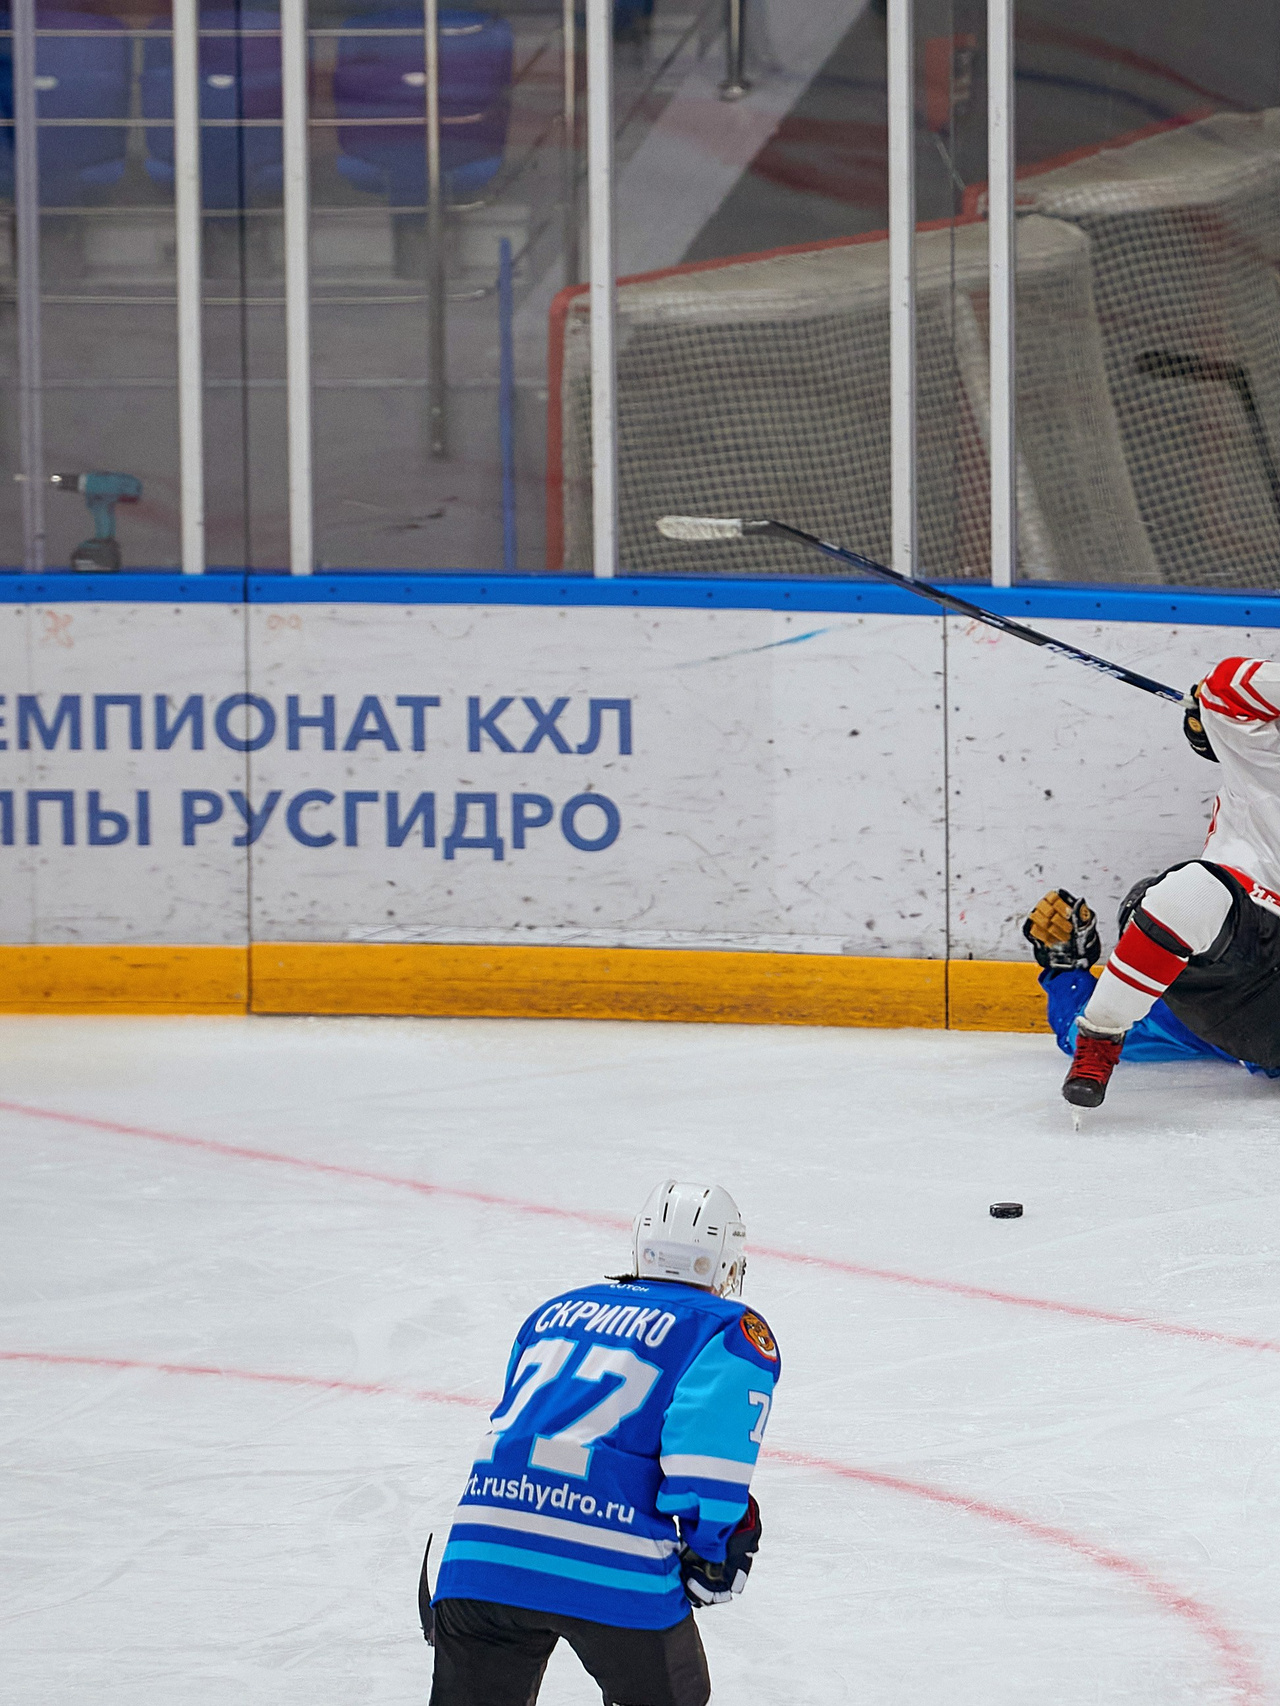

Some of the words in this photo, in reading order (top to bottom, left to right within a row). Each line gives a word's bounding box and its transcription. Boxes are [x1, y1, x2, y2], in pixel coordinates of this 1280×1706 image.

[0, 692, 441, 752] МПИОНАТ
[467, 696, 634, 755] КХЛ
[0, 789, 150, 847] ПЫ
[181, 787, 622, 860] РУСГИДРО
[533, 1299, 677, 1348] СКРИПКО
[472, 1336, 664, 1480] 77
